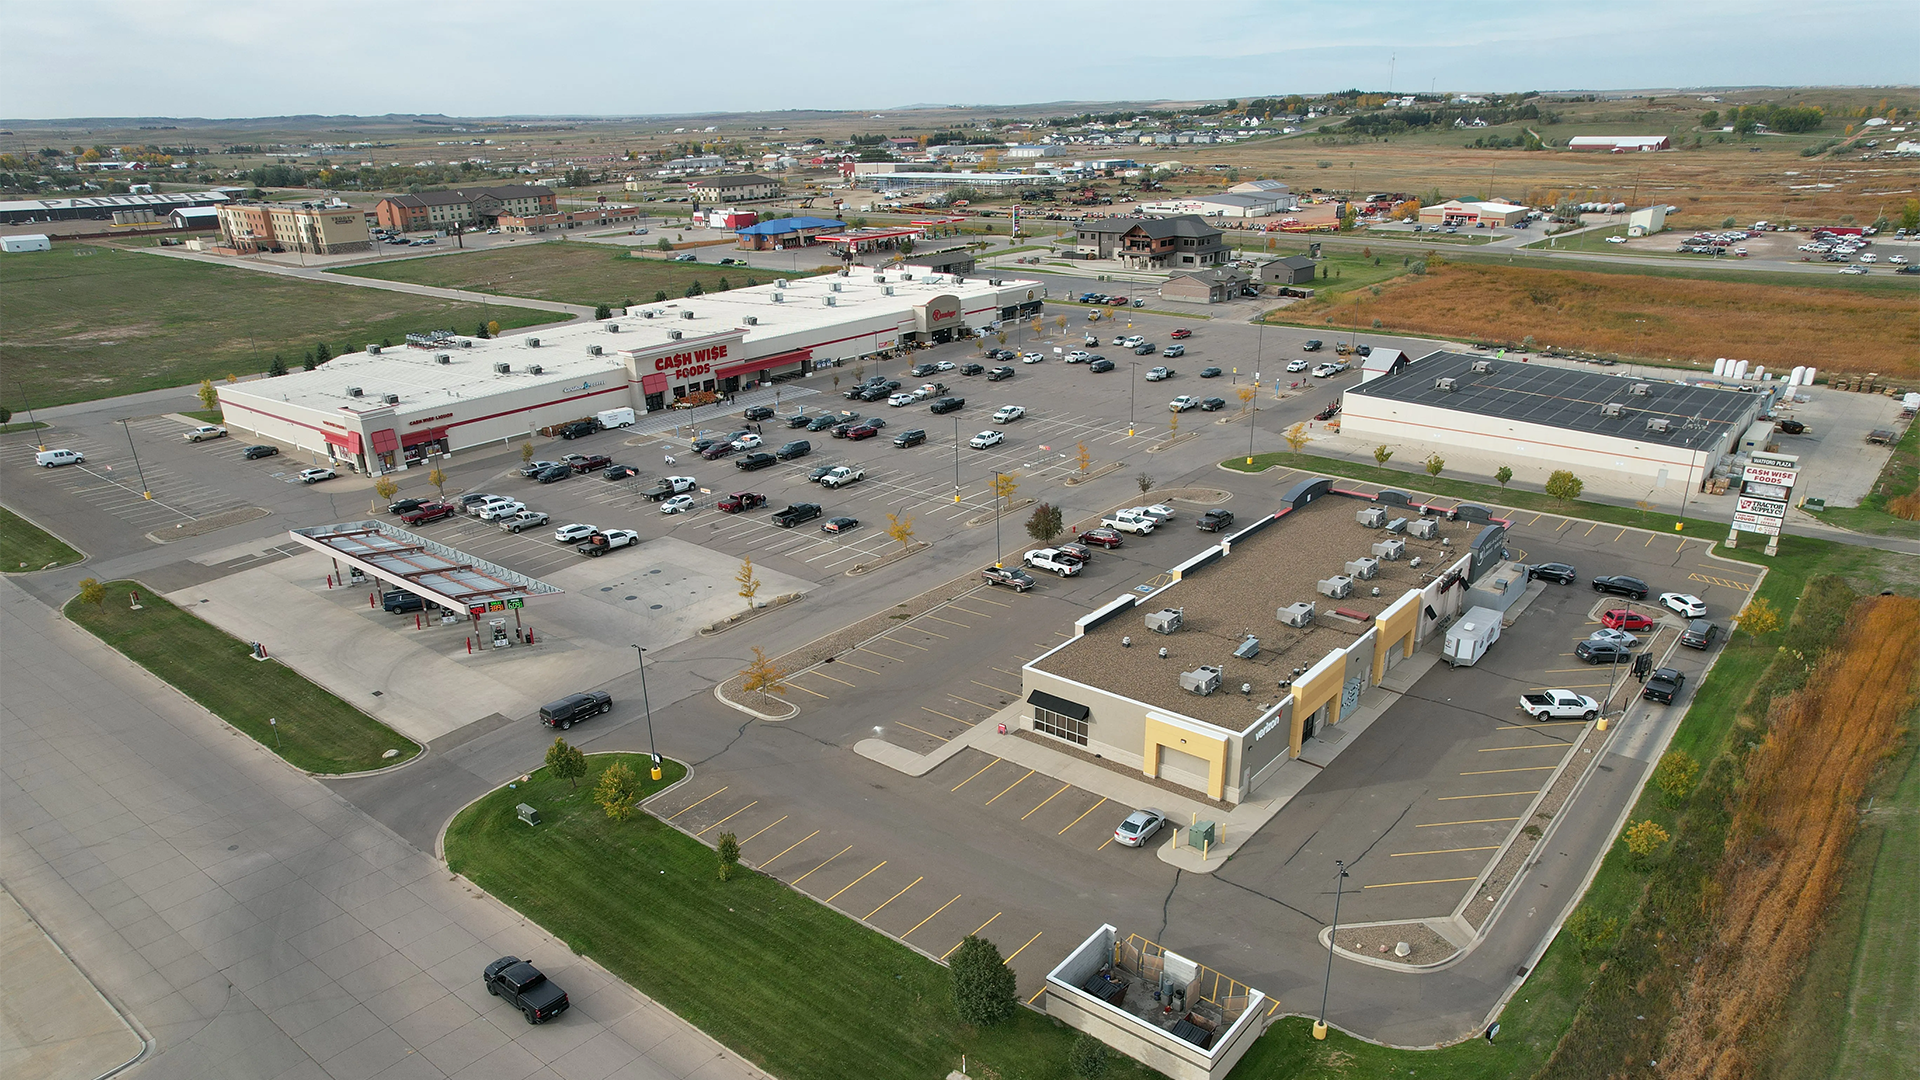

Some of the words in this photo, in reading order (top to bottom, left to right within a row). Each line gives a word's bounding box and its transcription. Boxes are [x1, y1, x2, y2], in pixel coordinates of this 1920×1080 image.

[39, 193, 213, 208] PANTHER
[675, 363, 710, 380] FOODS
[1754, 458, 1775, 466] WATFORD
[1746, 468, 1770, 476] CASH
[1771, 471, 1793, 479] WISE
[1754, 475, 1782, 484] FOODS
[1753, 501, 1783, 509] TRACTOR
[1751, 506, 1774, 514] SUPPLY
